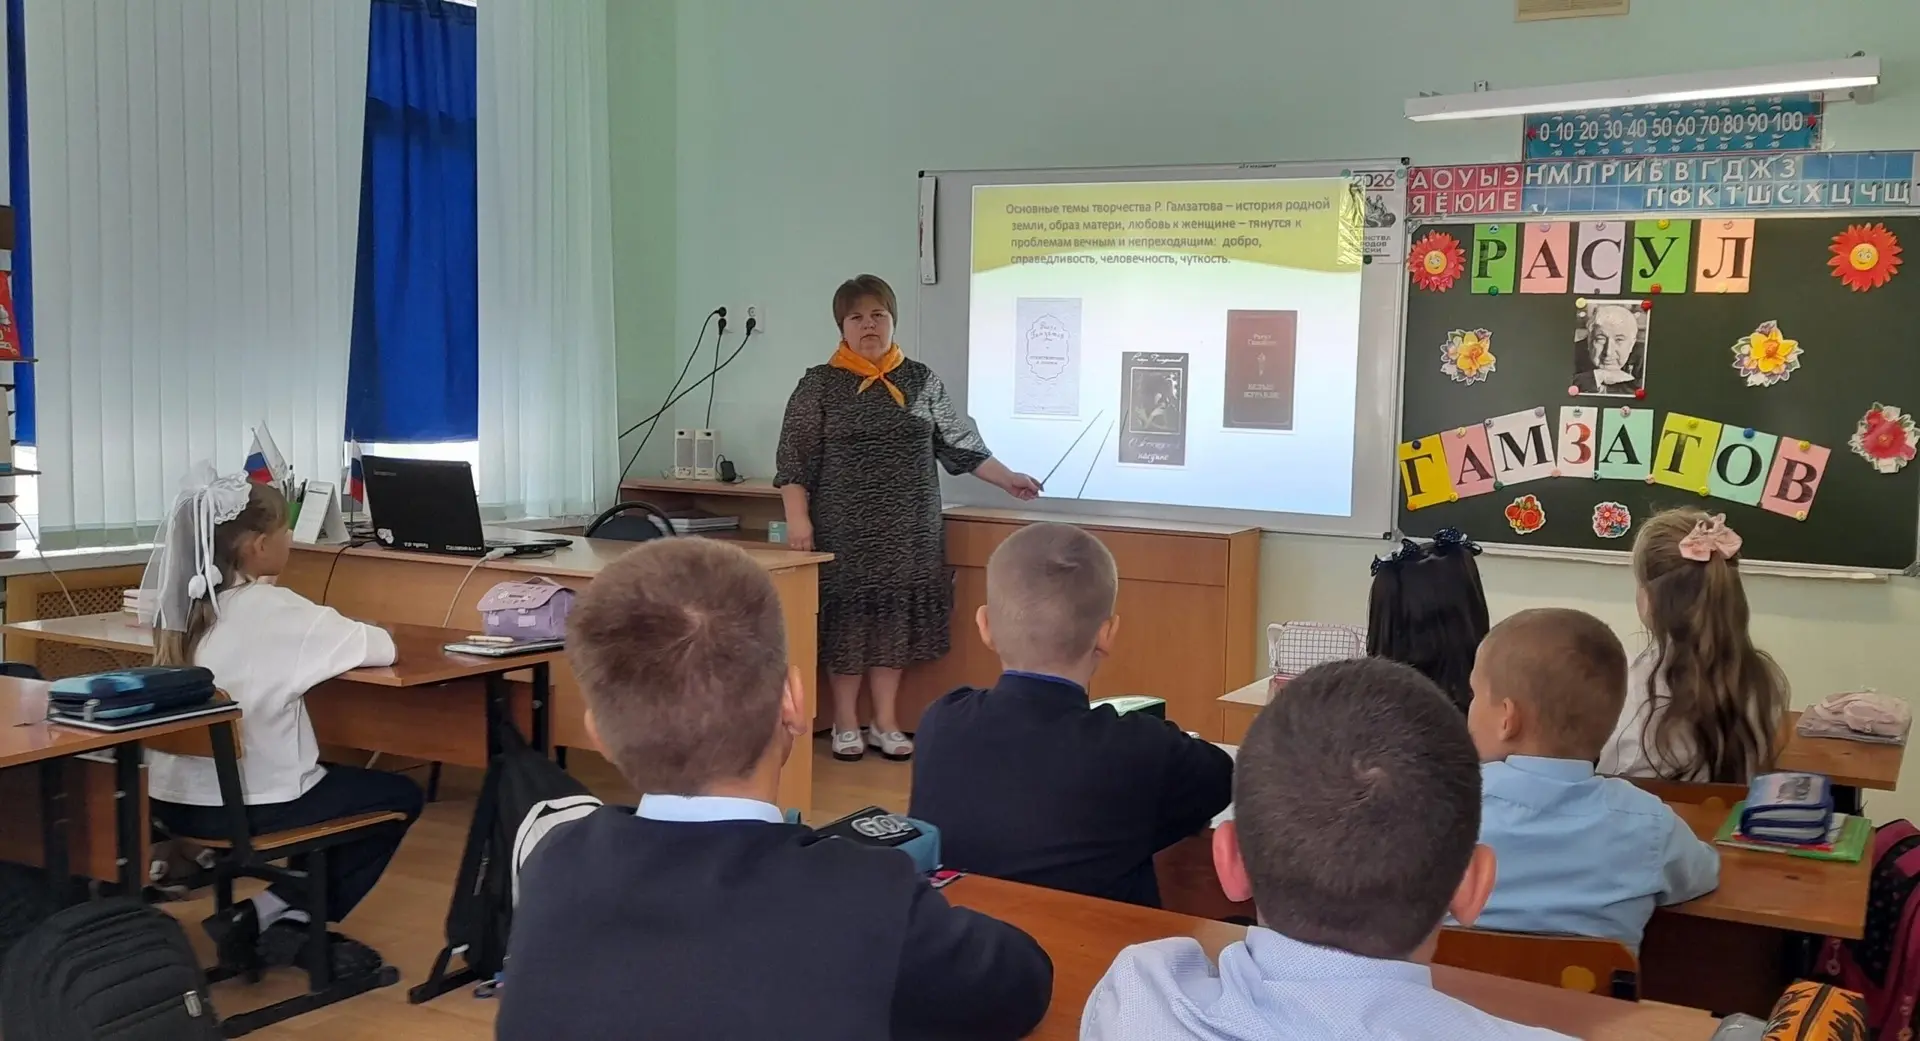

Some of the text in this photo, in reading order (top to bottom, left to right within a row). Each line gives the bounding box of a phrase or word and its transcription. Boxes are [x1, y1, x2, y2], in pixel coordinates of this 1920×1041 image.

[1540, 111, 1803, 141] 0 10 20 30 40 50 60 70 80 90 100
[1352, 173, 1395, 188] 2026
[1411, 171, 1428, 189] А
[1434, 170, 1452, 189] О
[1458, 169, 1473, 188] У
[1480, 168, 1498, 187] Ы
[1504, 167, 1520, 186] Э
[1526, 165, 1544, 185] Н
[1548, 165, 1569, 185] М
[1573, 164, 1593, 184] Л
[1602, 163, 1616, 183] Р
[1650, 161, 1664, 182] Б
[1675, 161, 1688, 181] В
[1702, 160, 1717, 180] Г
[1723, 160, 1743, 182] Д
[1749, 159, 1772, 179] Ж
[1780, 159, 1795, 178] З
[1006, 203, 1060, 214] Основные
[1062, 204, 1089, 213] темы
[1092, 202, 1152, 214] творчества
[1154, 201, 1163, 212] Р.
[1166, 201, 1223, 212] Гамзатова
[1236, 200, 1282, 212] история
[1286, 197, 1330, 212] родной
[1412, 182, 1910, 214] Я Ё Ю И Е П Ф К Т Ш С Х Ц Ч Щ
[1012, 221, 1047, 232] земли,
[1049, 220, 1080, 231] образ
[1083, 220, 1125, 231] матери,
[1128, 218, 1170, 230] любовь
[1182, 219, 1236, 230] женщине
[1249, 218, 1291, 230] тянутся
[1295, 219, 1302, 228] к
[1011, 236, 1262, 248] проблемам вечным и непреходящим: добро,
[1010, 254, 1230, 266] справедливость, человечность, чуткость.
[1400, 422, 1818, 504] ГАМЗАТОВ
